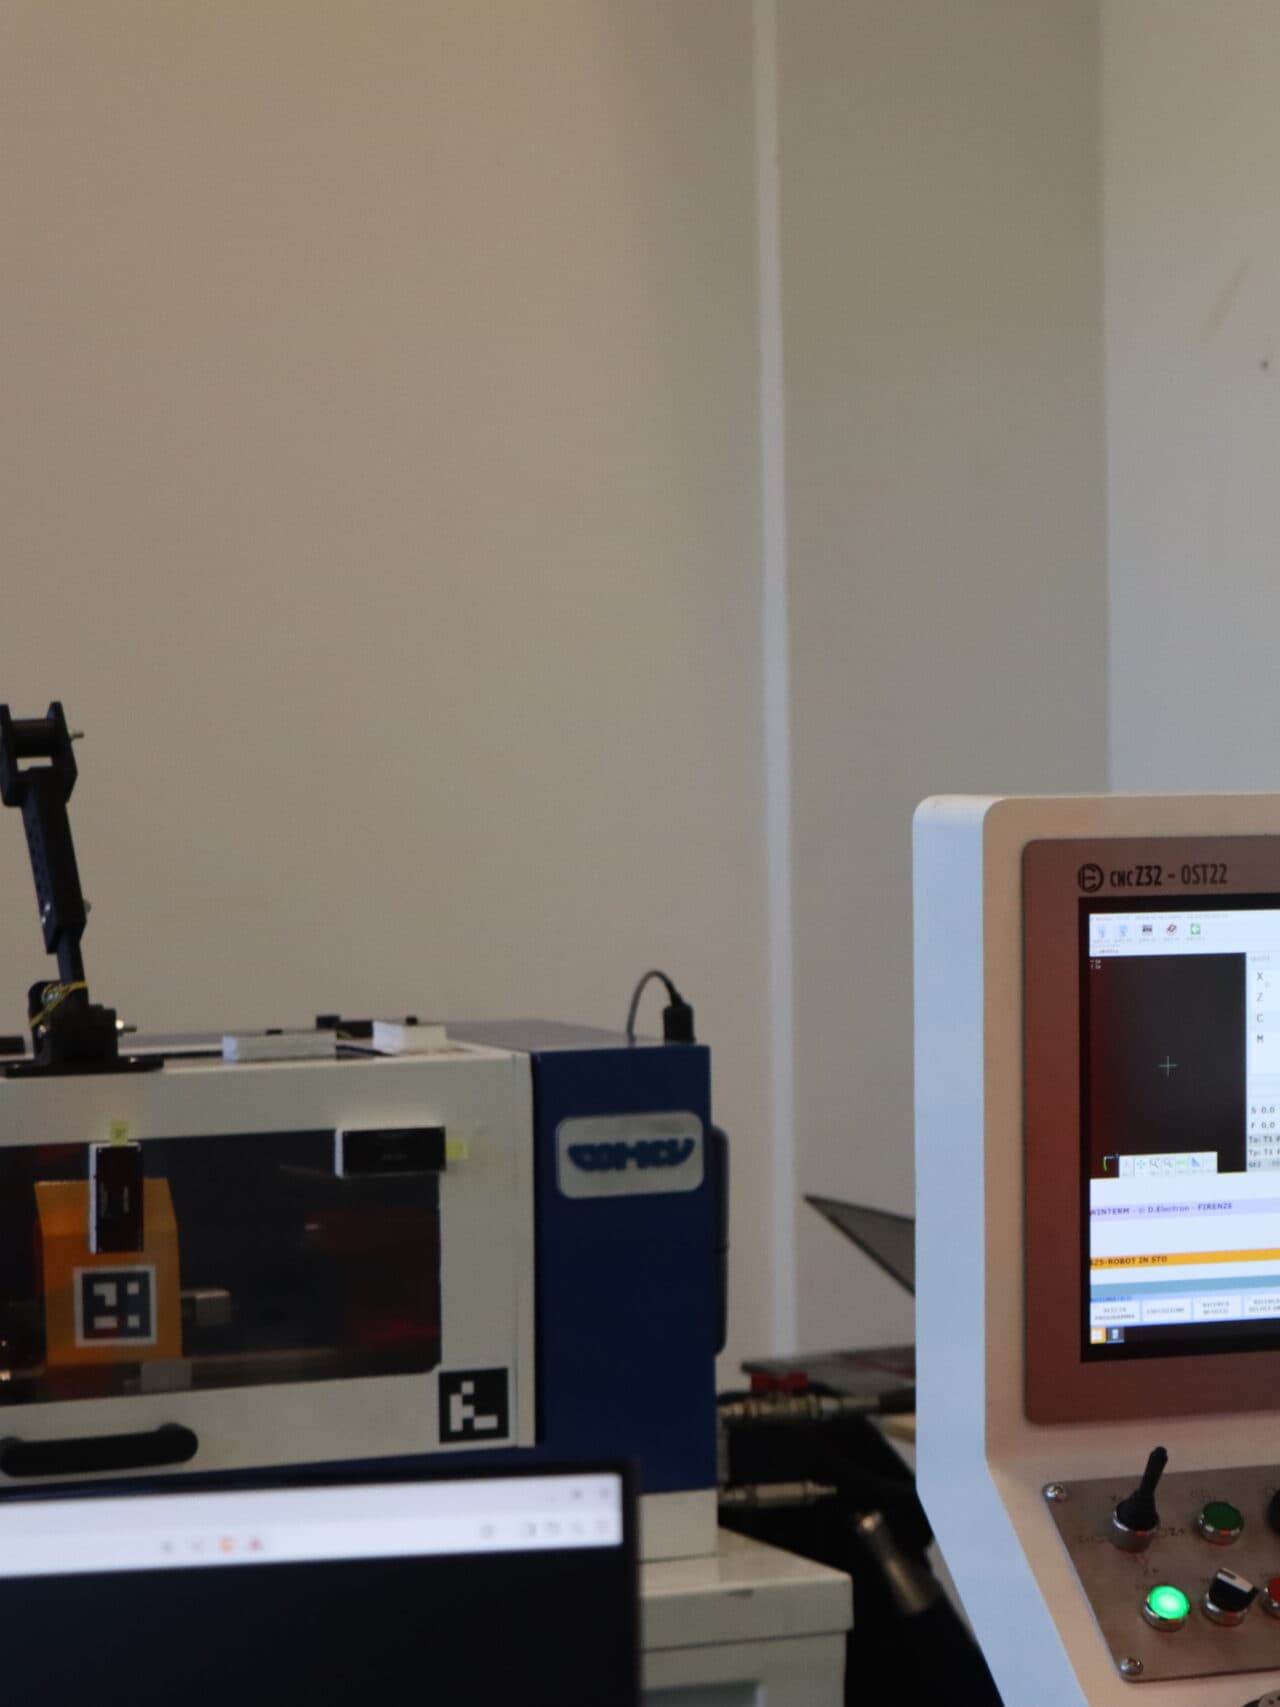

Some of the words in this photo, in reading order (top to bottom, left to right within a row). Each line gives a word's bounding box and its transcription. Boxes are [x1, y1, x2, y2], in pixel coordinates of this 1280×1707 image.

[1256, 972, 1264, 981] X
[1256, 993, 1264, 1002] Z
[1256, 1013, 1264, 1023] C
[1256, 1034, 1264, 1043] M
